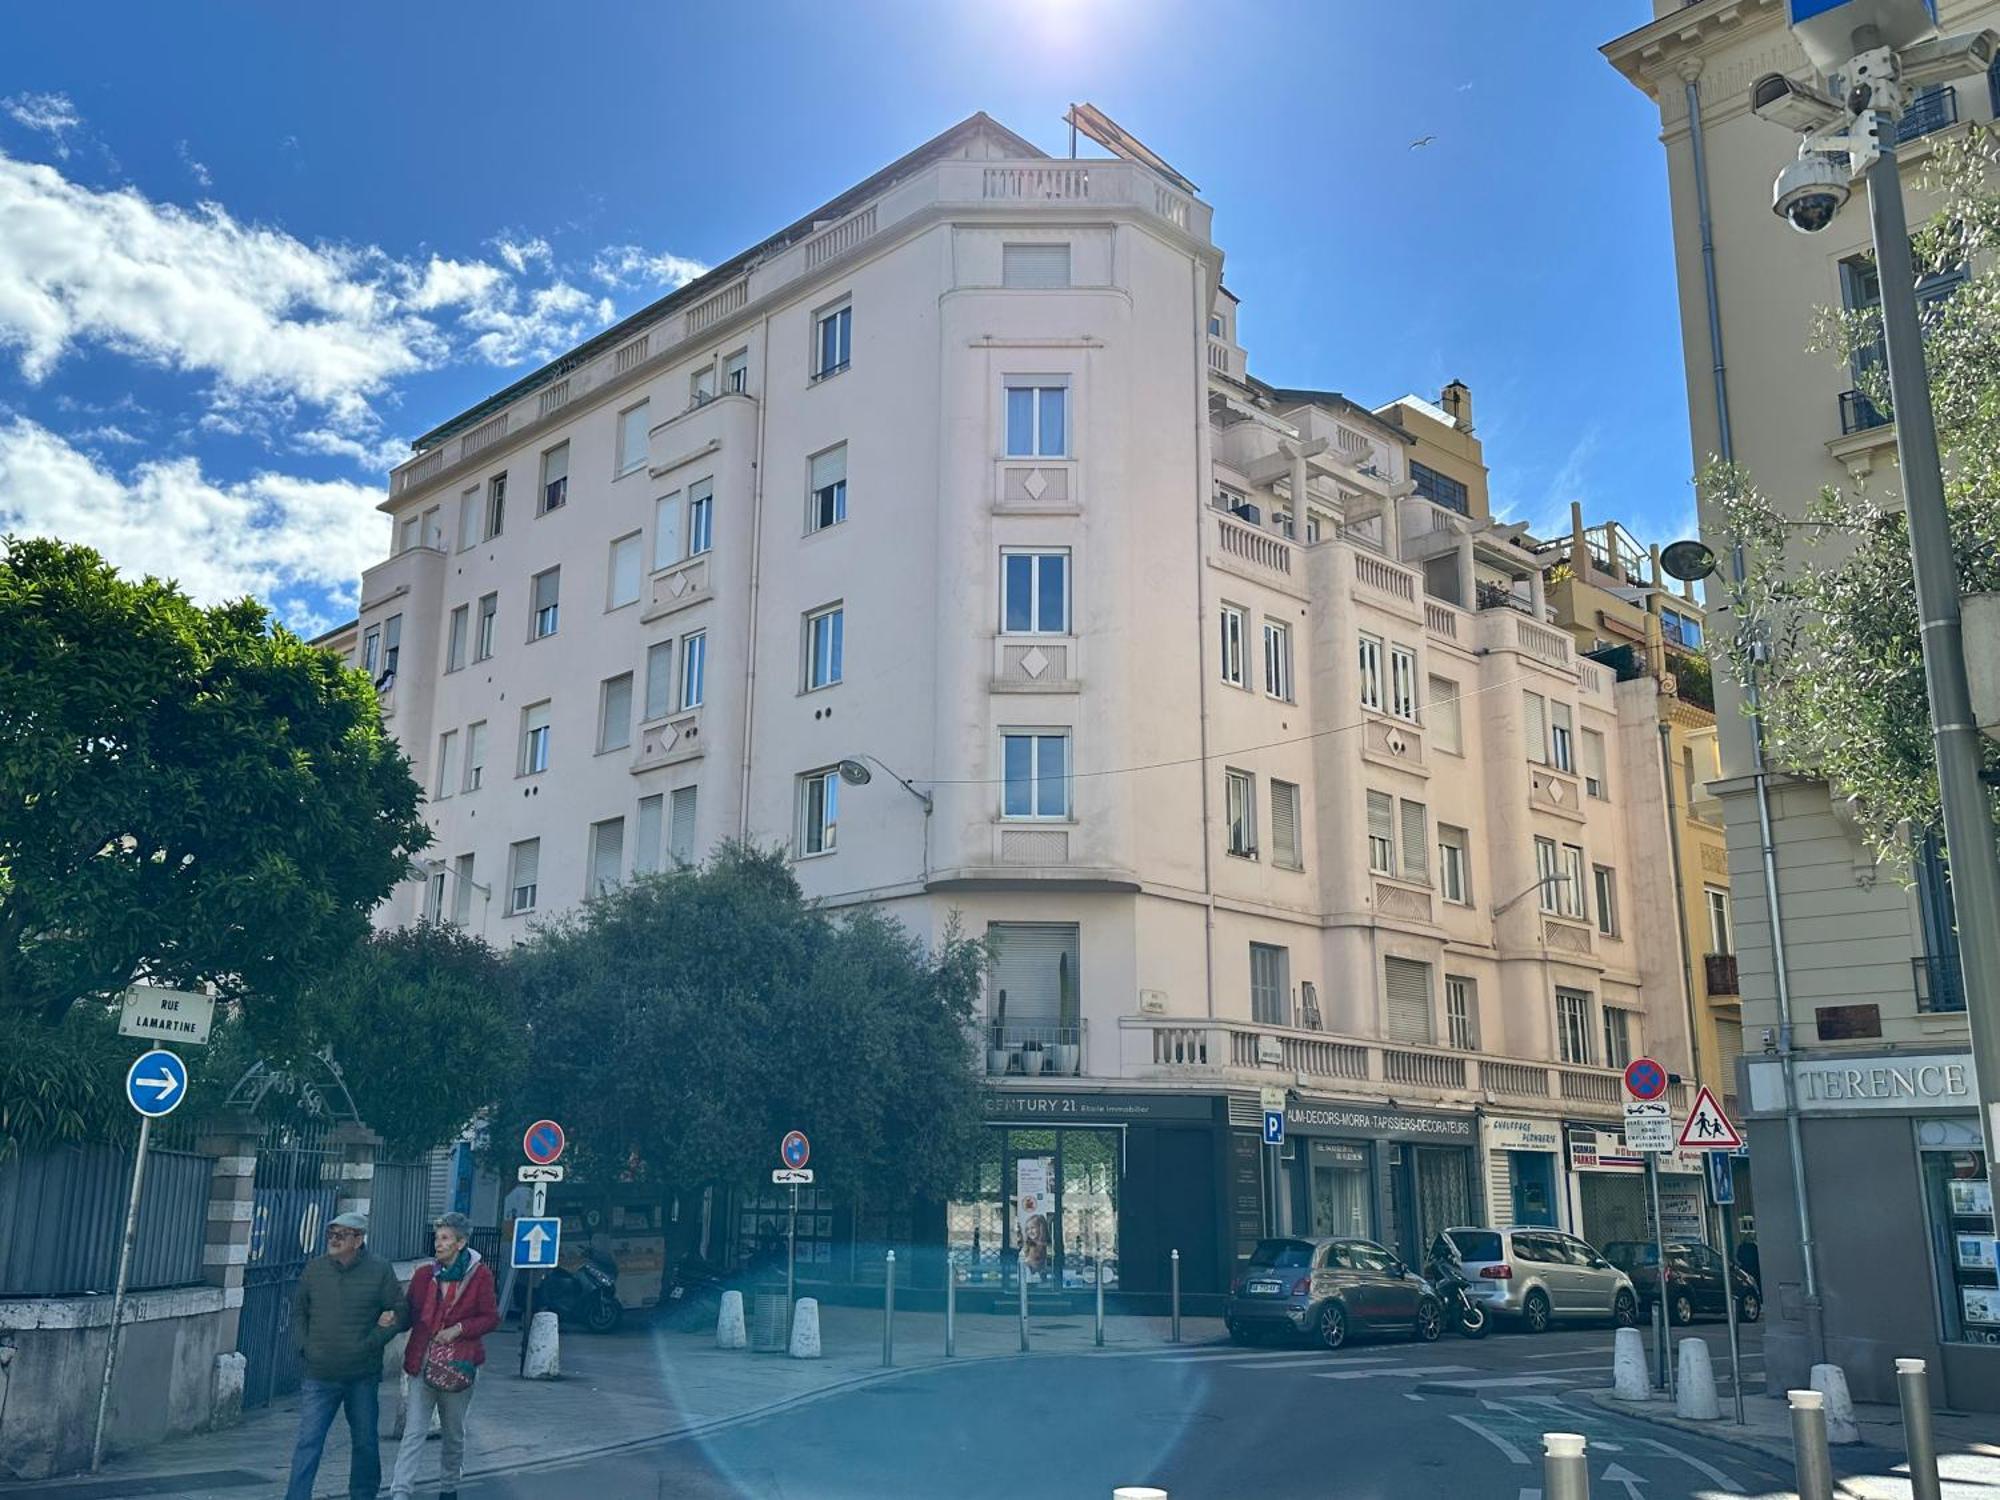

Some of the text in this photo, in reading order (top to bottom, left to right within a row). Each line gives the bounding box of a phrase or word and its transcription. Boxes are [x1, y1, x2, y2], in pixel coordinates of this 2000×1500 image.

[161, 999, 180, 1011] RUE
[136, 1015, 196, 1033] LAMARTINE
[1801, 1064, 1968, 1100] TERENCE
[985, 1099, 1058, 1112] CENTURY
[1572, 1145, 1596, 1154] NORMAN
[1573, 1155, 1597, 1165] PARKER
